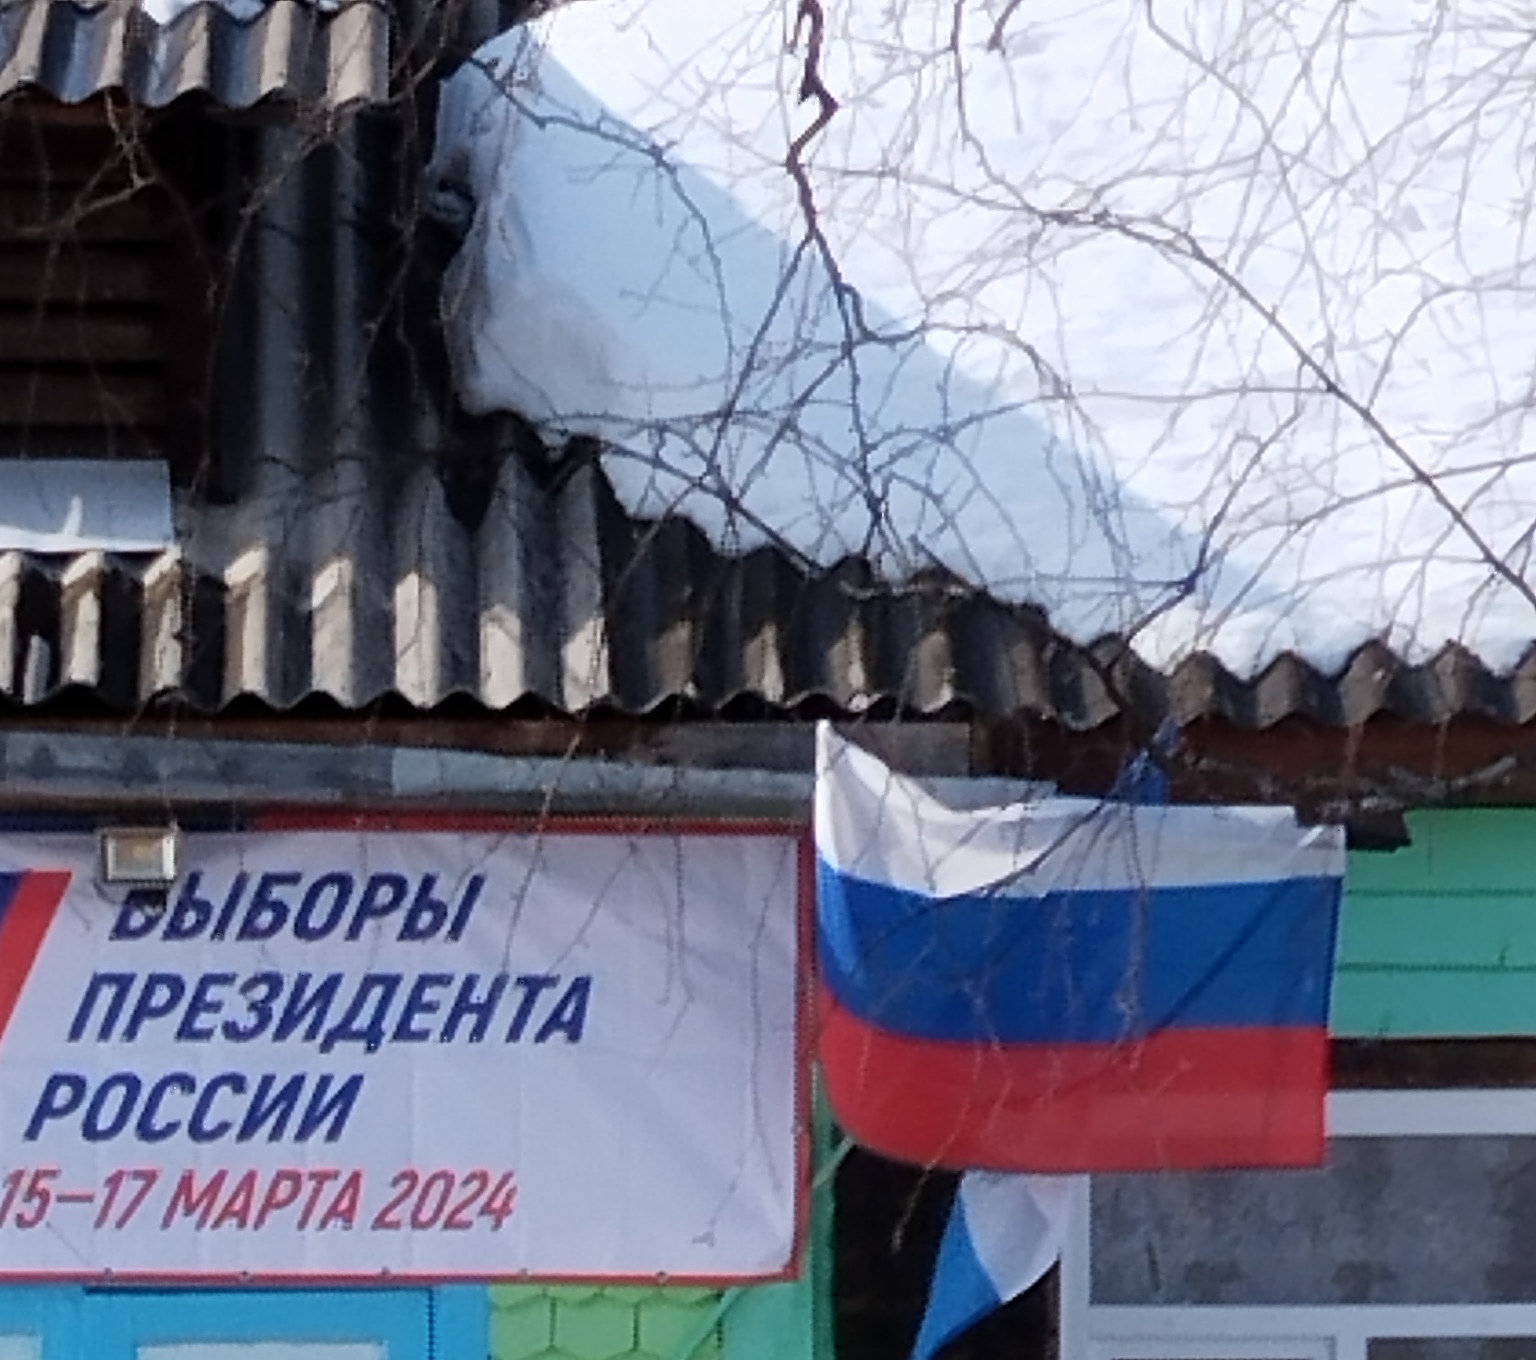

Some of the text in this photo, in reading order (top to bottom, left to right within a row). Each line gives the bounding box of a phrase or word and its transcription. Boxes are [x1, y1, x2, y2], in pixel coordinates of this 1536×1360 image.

[68, 971, 592, 1054] ПРЕЗИДЕНТА
[24, 1071, 364, 1144] РОССИИ
[161, 1169, 361, 1231] МАРТА
[373, 1168, 518, 1231] 2024
